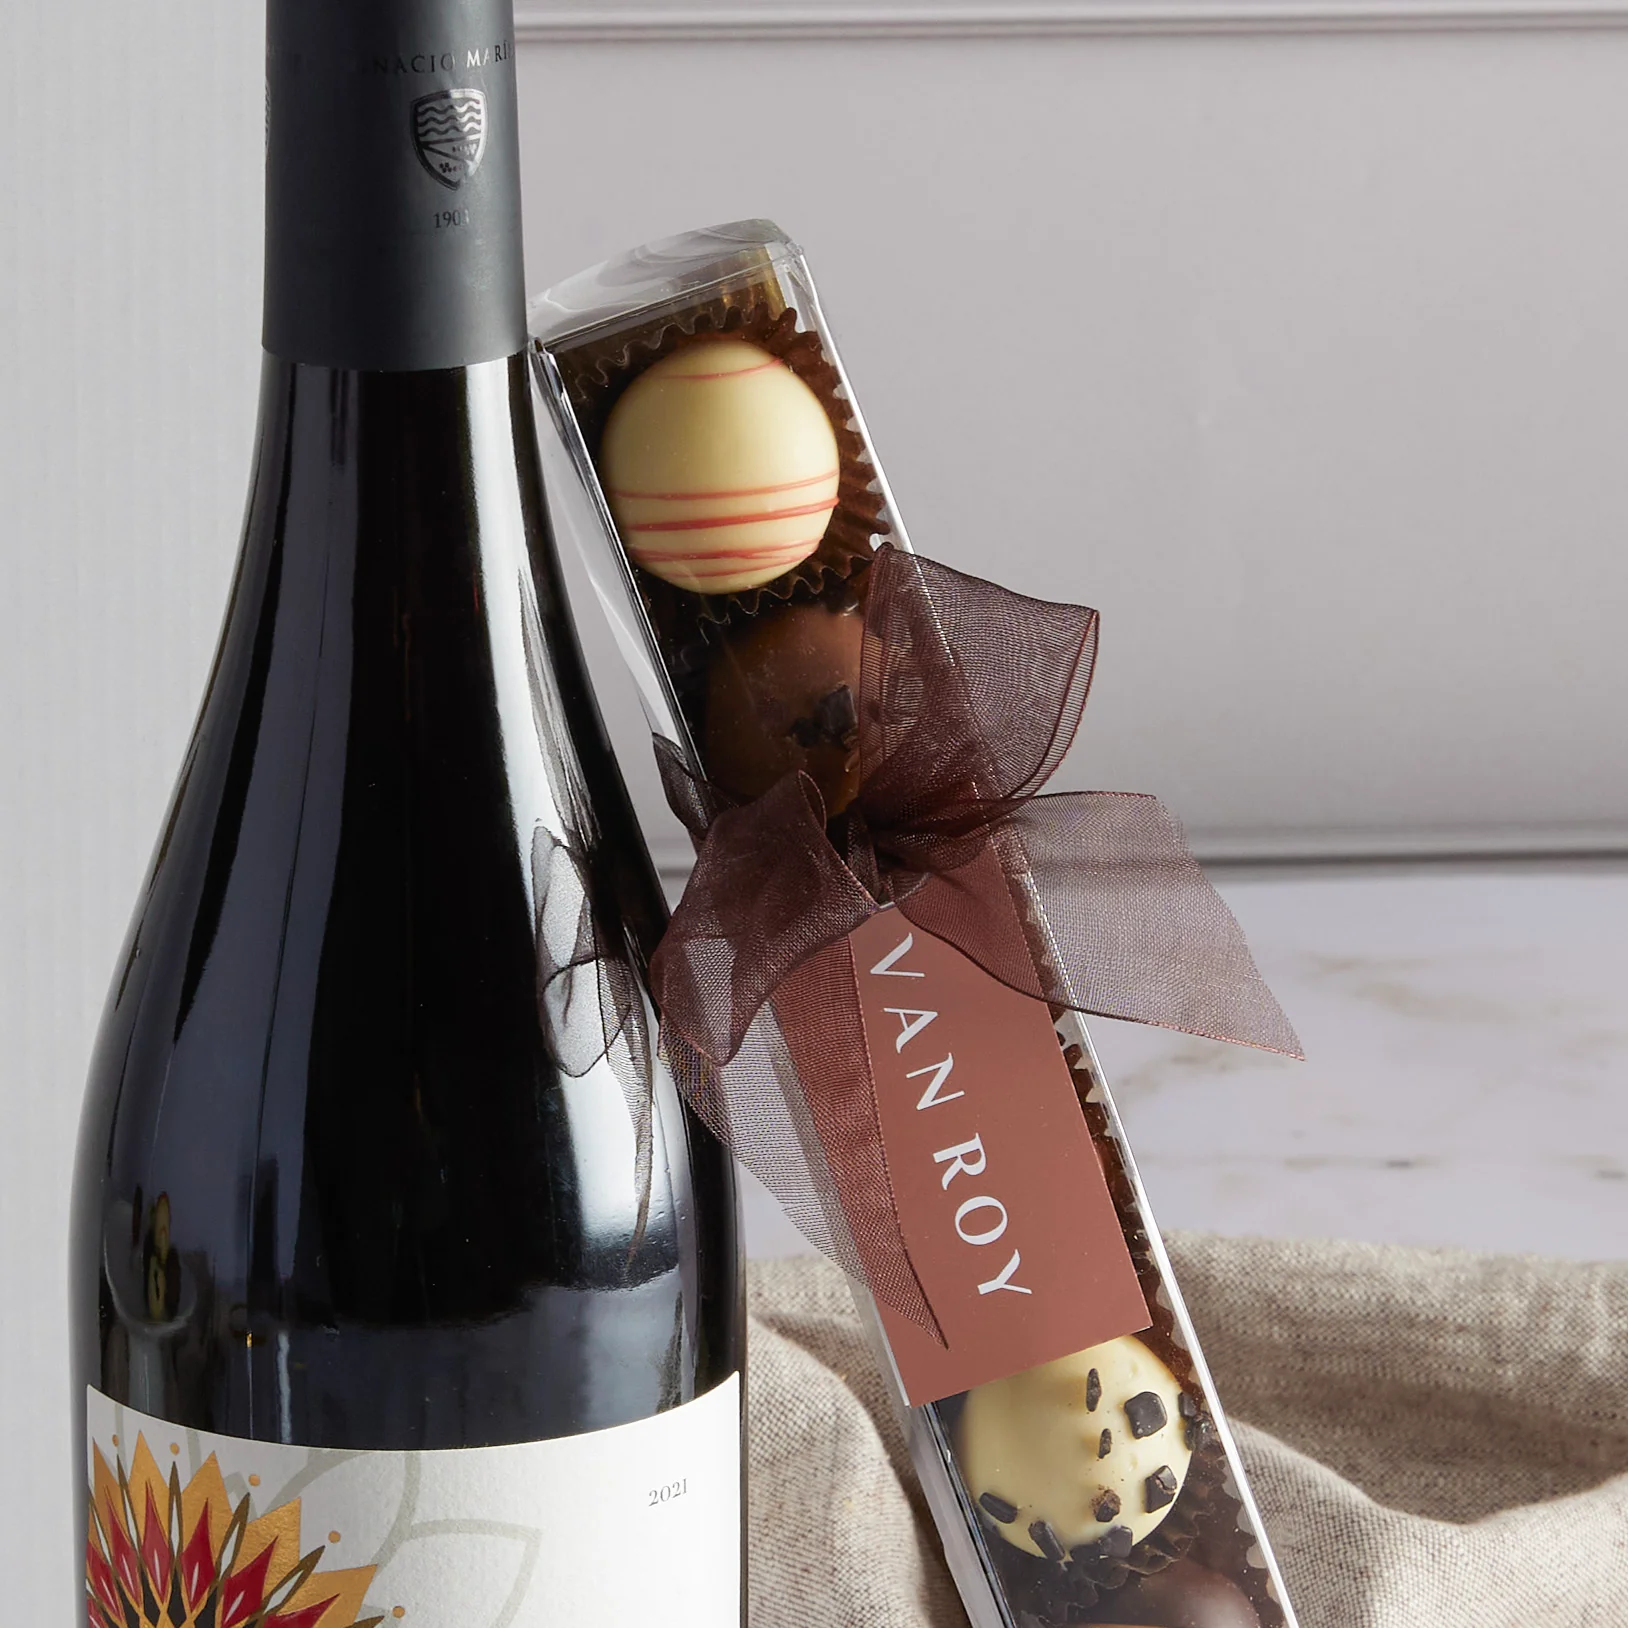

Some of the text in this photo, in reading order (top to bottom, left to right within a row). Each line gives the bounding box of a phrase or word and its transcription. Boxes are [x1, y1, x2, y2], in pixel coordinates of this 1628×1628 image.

[366, 53, 456, 74] NACIO
[869, 931, 1033, 1296] VAN ROY
[648, 1477, 688, 1508] 2021
